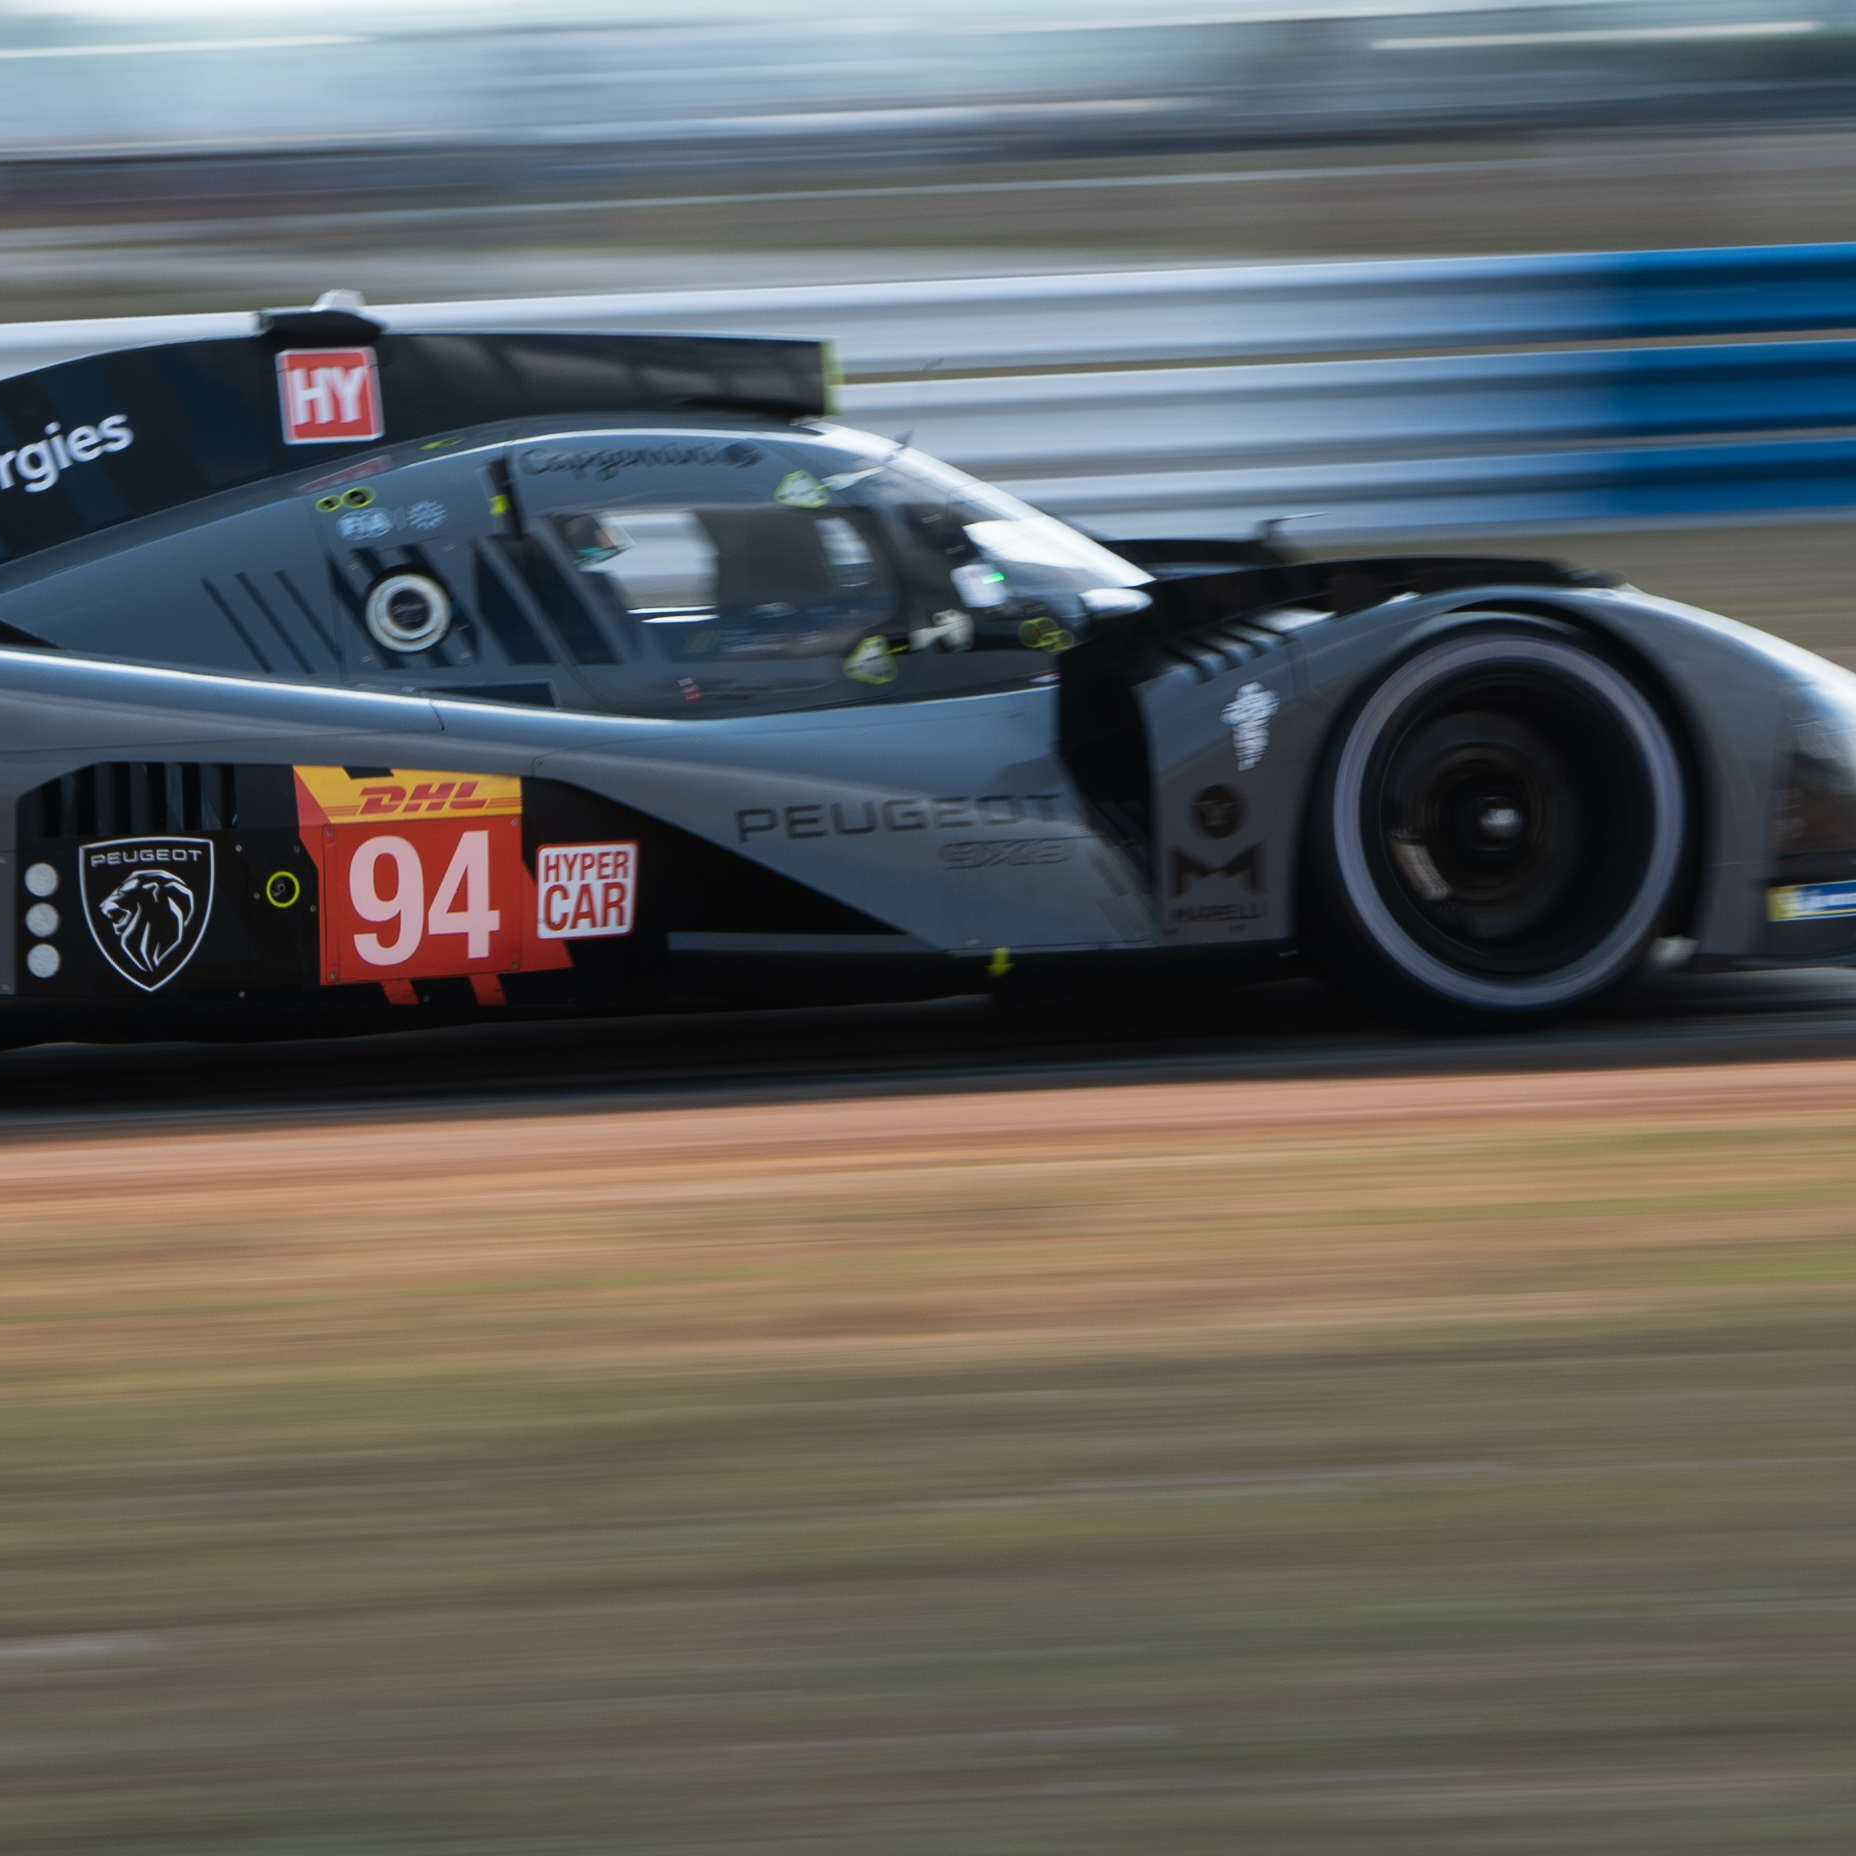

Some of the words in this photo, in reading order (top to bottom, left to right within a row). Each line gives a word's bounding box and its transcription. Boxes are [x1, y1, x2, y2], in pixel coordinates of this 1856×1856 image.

[287, 366, 369, 425] HY
[357, 780, 490, 815] DHL
[734, 793, 1063, 844] PEUGEOT
[89, 848, 203, 868] PEUGEOT
[543, 850, 630, 883] HYPER
[349, 830, 501, 967] 94
[543, 881, 628, 932] CAR
